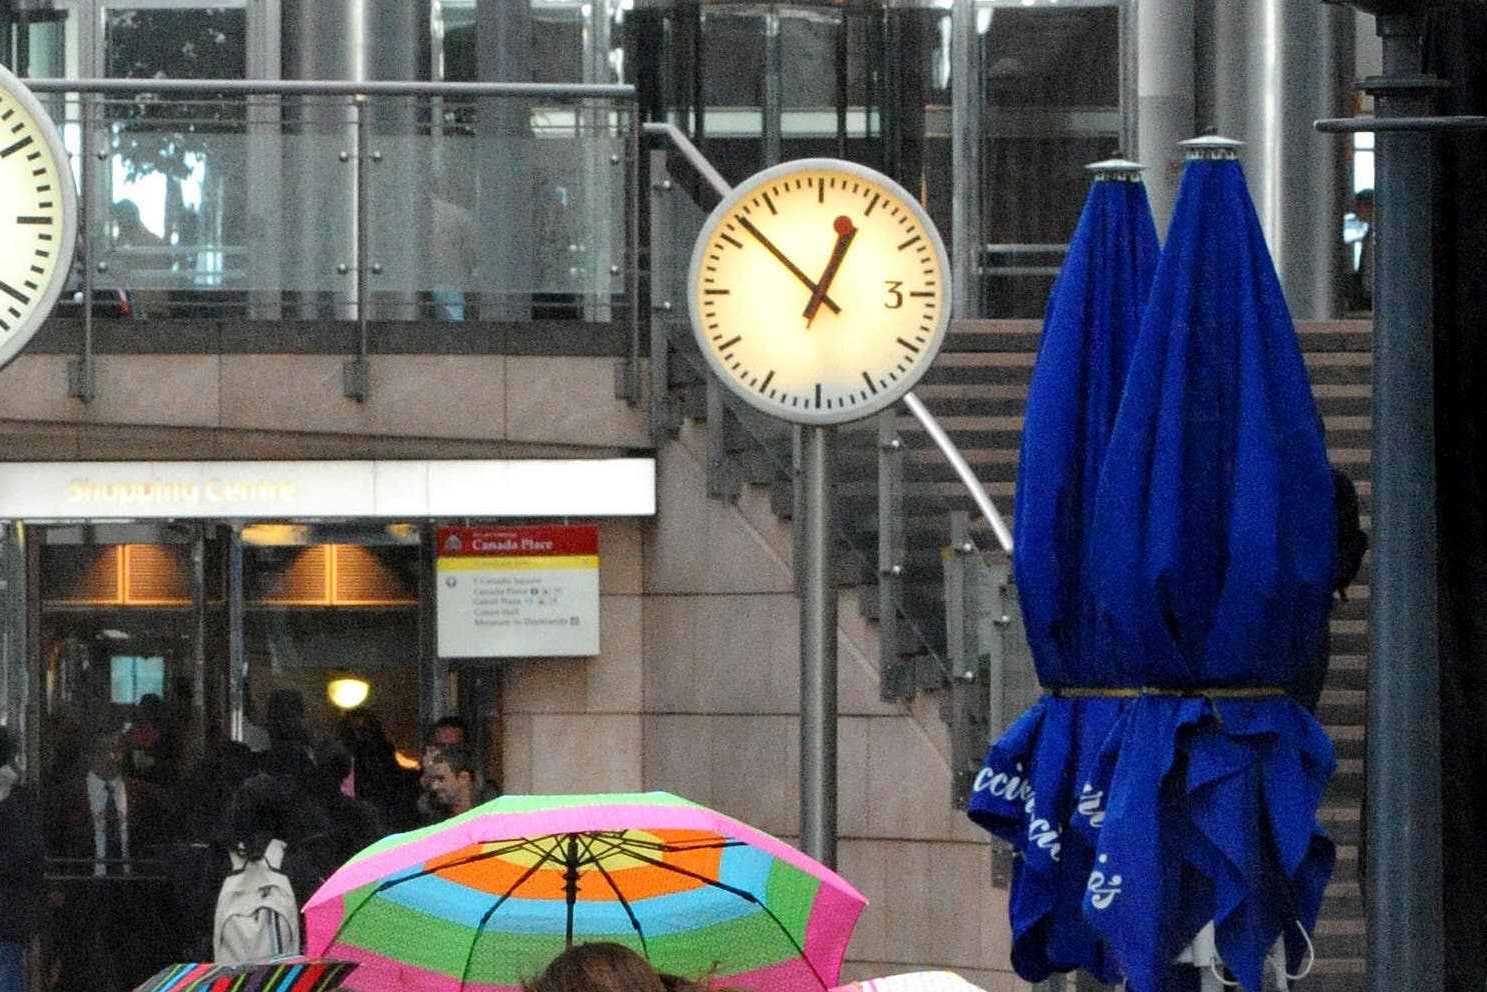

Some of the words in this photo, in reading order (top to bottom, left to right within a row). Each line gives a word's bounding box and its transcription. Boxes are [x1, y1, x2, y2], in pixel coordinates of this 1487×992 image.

[884, 280, 903, 309] 3
[68, 477, 199, 508] Shopping
[205, 477, 297, 503] Centre
[472, 538, 518, 551] Canada
[520, 538, 554, 550] Place
